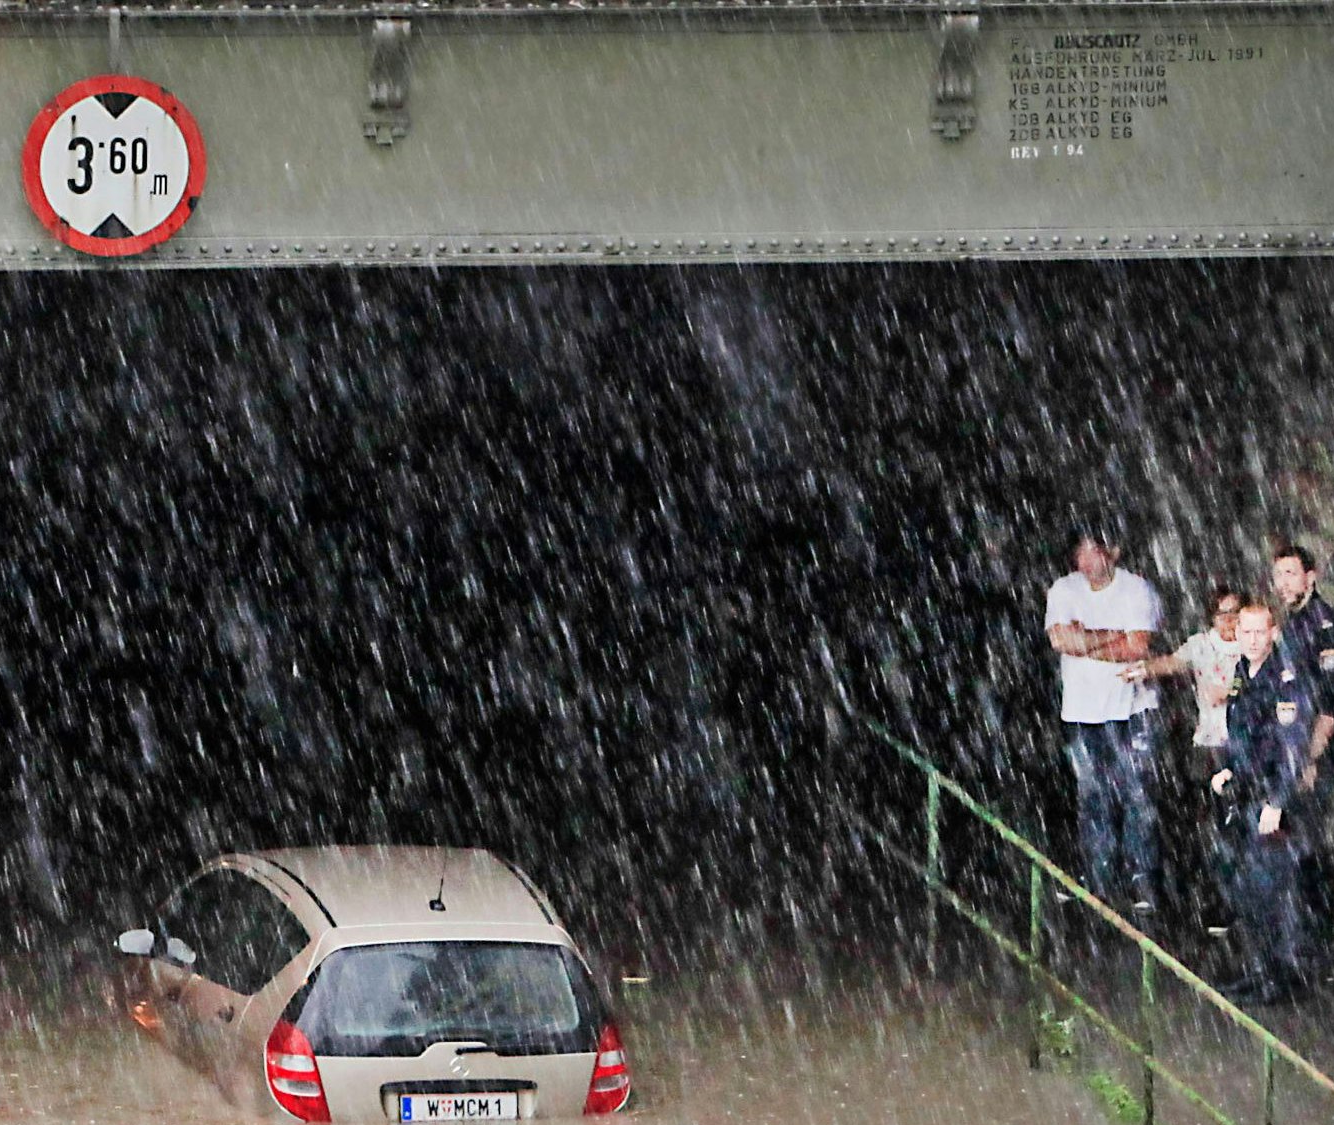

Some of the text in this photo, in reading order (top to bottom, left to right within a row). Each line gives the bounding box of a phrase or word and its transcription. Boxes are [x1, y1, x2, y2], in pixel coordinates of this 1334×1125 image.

[1045, 111, 1100, 124] ALKYD
[1045, 126, 1100, 139] ALKYD
[427, 1098, 502, 1117] W MCM 1
